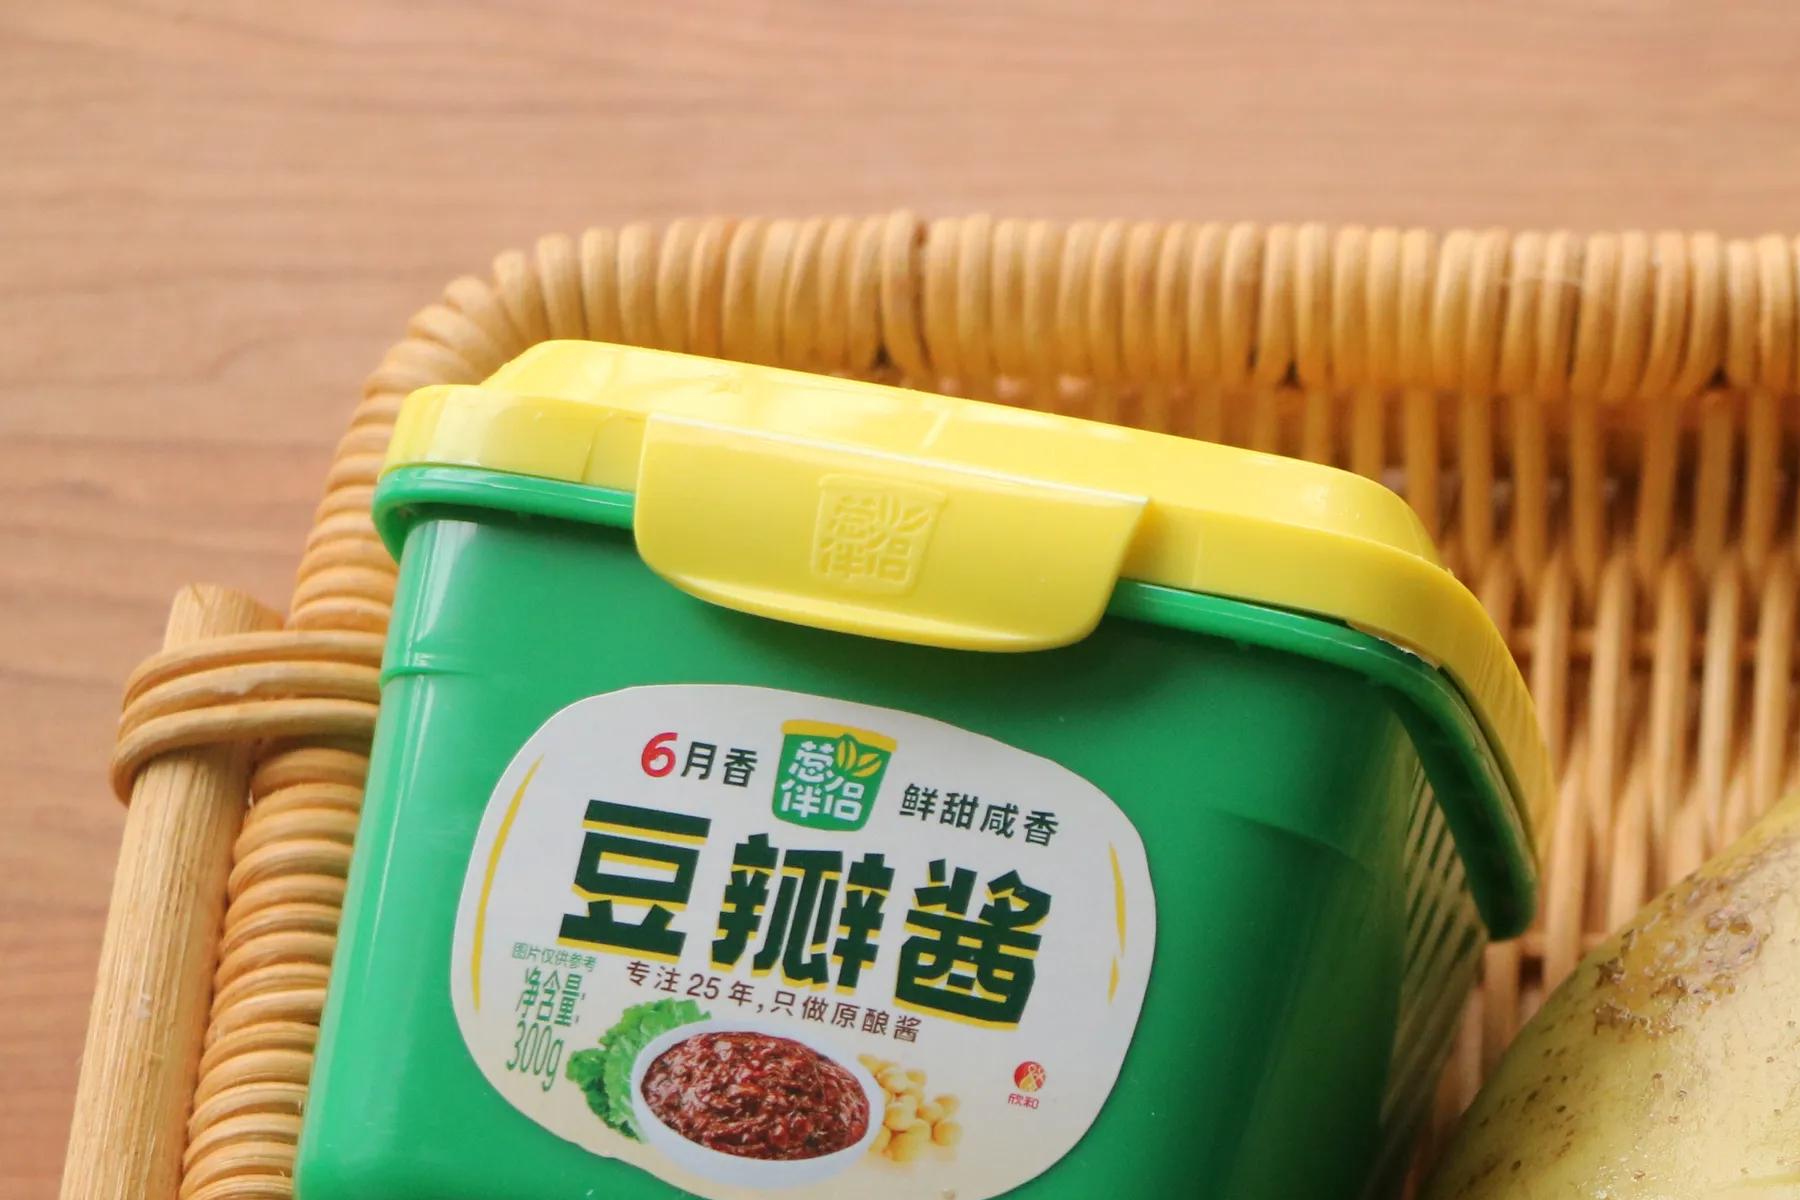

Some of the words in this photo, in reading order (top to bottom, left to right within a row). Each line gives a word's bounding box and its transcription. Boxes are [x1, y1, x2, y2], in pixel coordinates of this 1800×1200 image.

[641, 732, 759, 788] 6月香
[899, 783, 1059, 847] 鲜甜咸香
[557, 799, 1051, 1031] 豆瓣酱
[511, 942, 598, 972] 图片仅供参考
[506, 1020, 564, 1092] 300g
